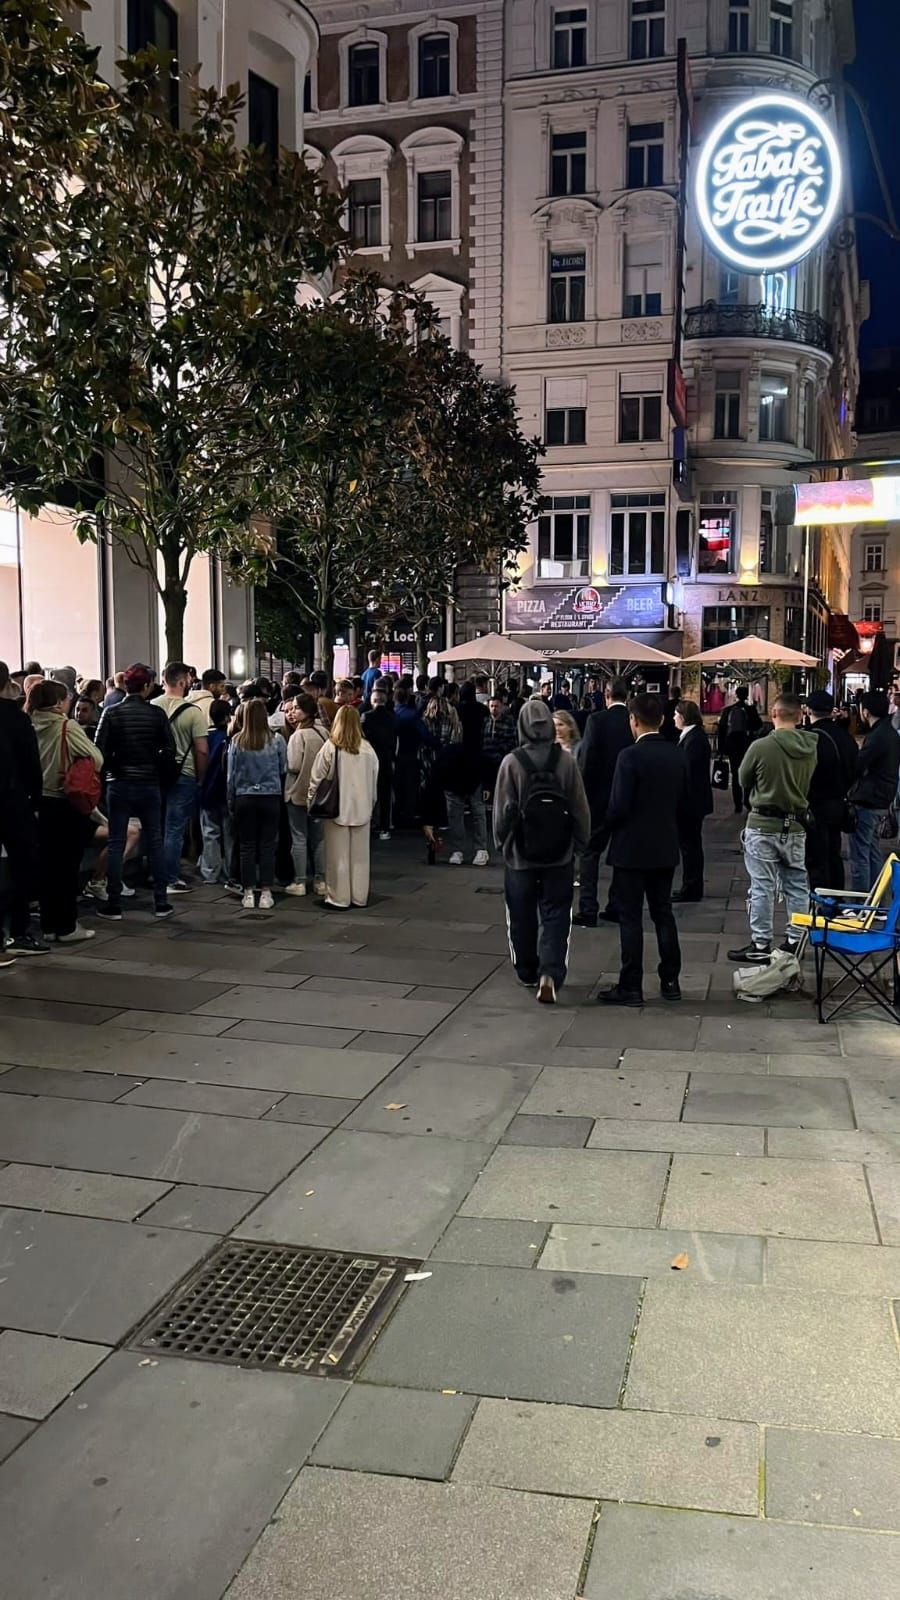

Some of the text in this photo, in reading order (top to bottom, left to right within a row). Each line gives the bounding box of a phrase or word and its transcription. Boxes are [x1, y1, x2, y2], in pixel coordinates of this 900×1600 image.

[711, 135, 824, 186] Tabak
[711, 175, 824, 227] Trafik
[717, 590, 759, 602] LANZ
[517, 599, 546, 613] PIZZA
[626, 598, 653, 611] BEER
[550, 620, 587, 628] RESTAURANT
